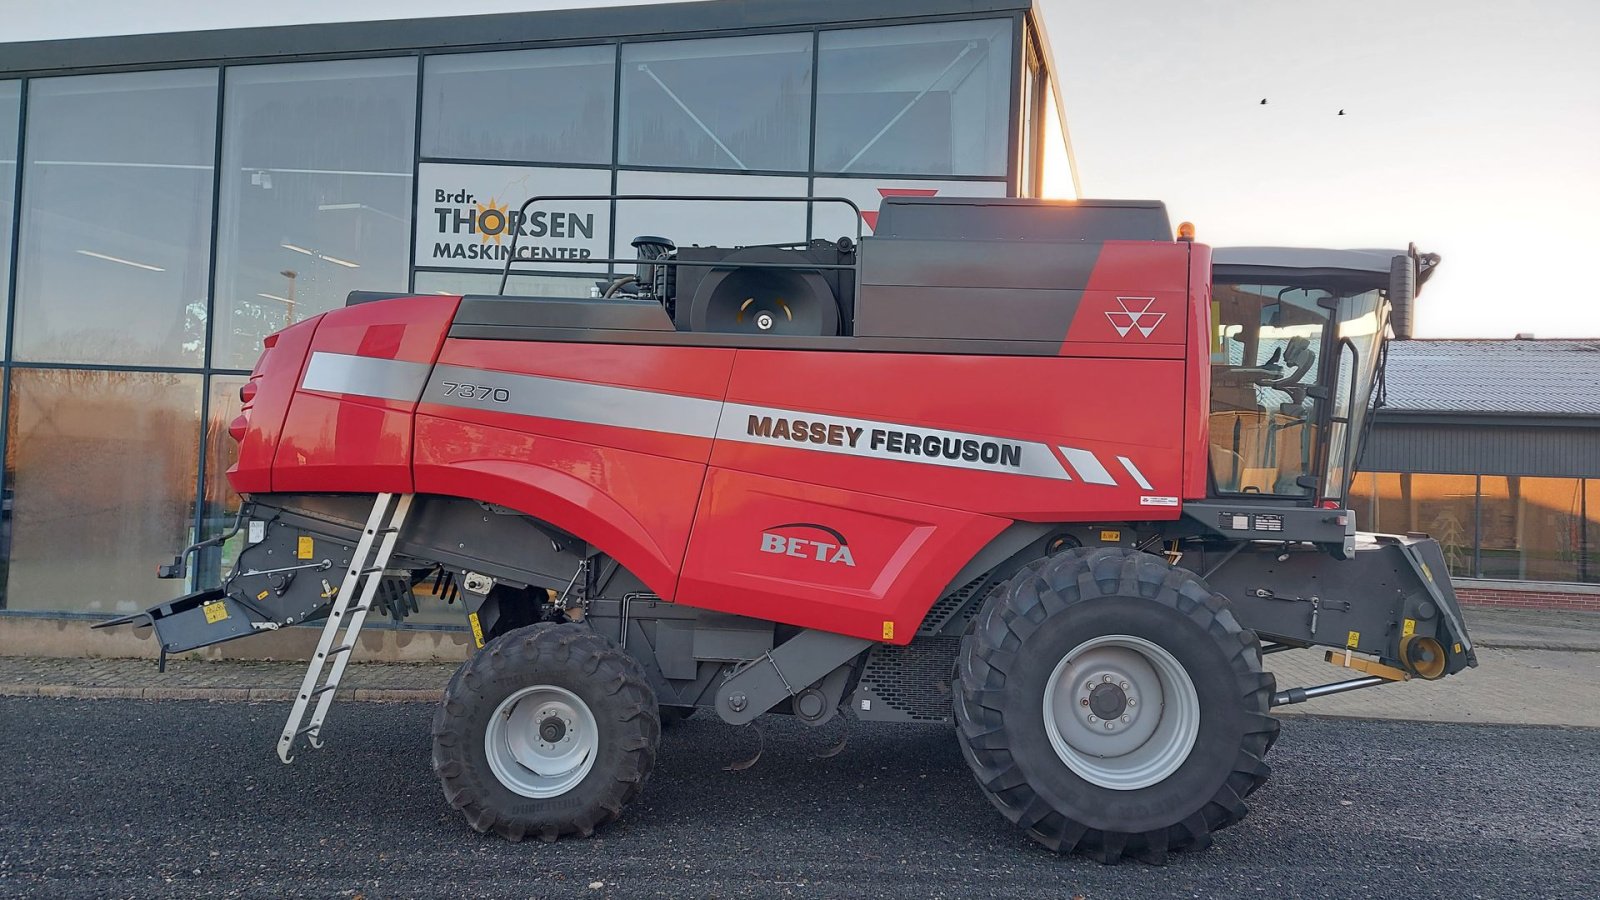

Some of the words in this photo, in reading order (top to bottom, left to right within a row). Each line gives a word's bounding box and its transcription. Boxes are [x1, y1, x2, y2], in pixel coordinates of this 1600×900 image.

[435, 188, 477, 205] Brdr.
[434, 207, 594, 239] THORSEN
[432, 242, 591, 263] MASKINCENTER
[443, 381, 511, 403] 7370
[746, 414, 864, 448] MASSEY
[870, 428, 1022, 467] FERGUSON
[760, 532, 857, 567] BETA
